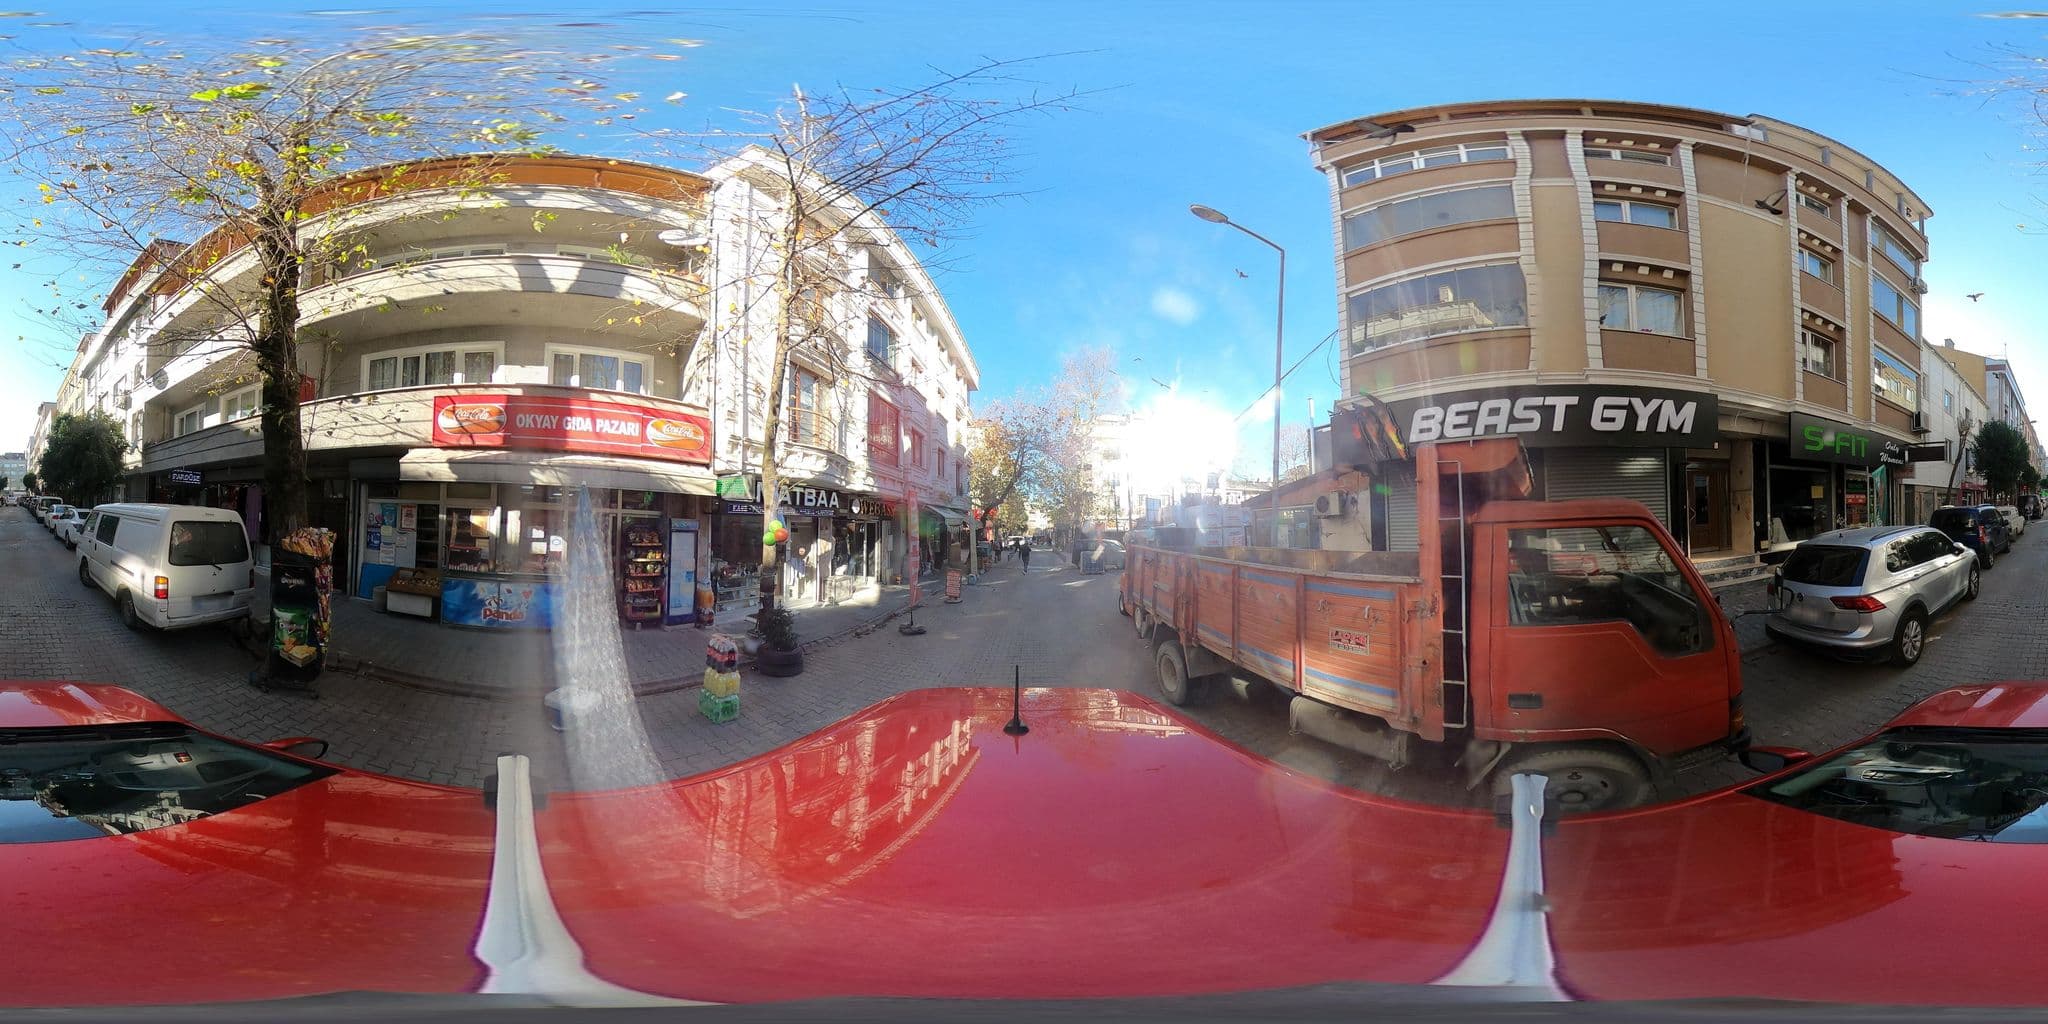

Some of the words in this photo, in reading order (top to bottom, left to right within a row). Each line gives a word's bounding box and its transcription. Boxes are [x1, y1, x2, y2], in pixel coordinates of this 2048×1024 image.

[516, 413, 558, 429] OKYAY
[563, 416, 593, 432] GIDA
[596, 418, 640, 436] PAZARI
[1409, 396, 1579, 443] BEAST
[1590, 396, 1697, 434] GYM
[1803, 425, 1869, 458] S-FIT
